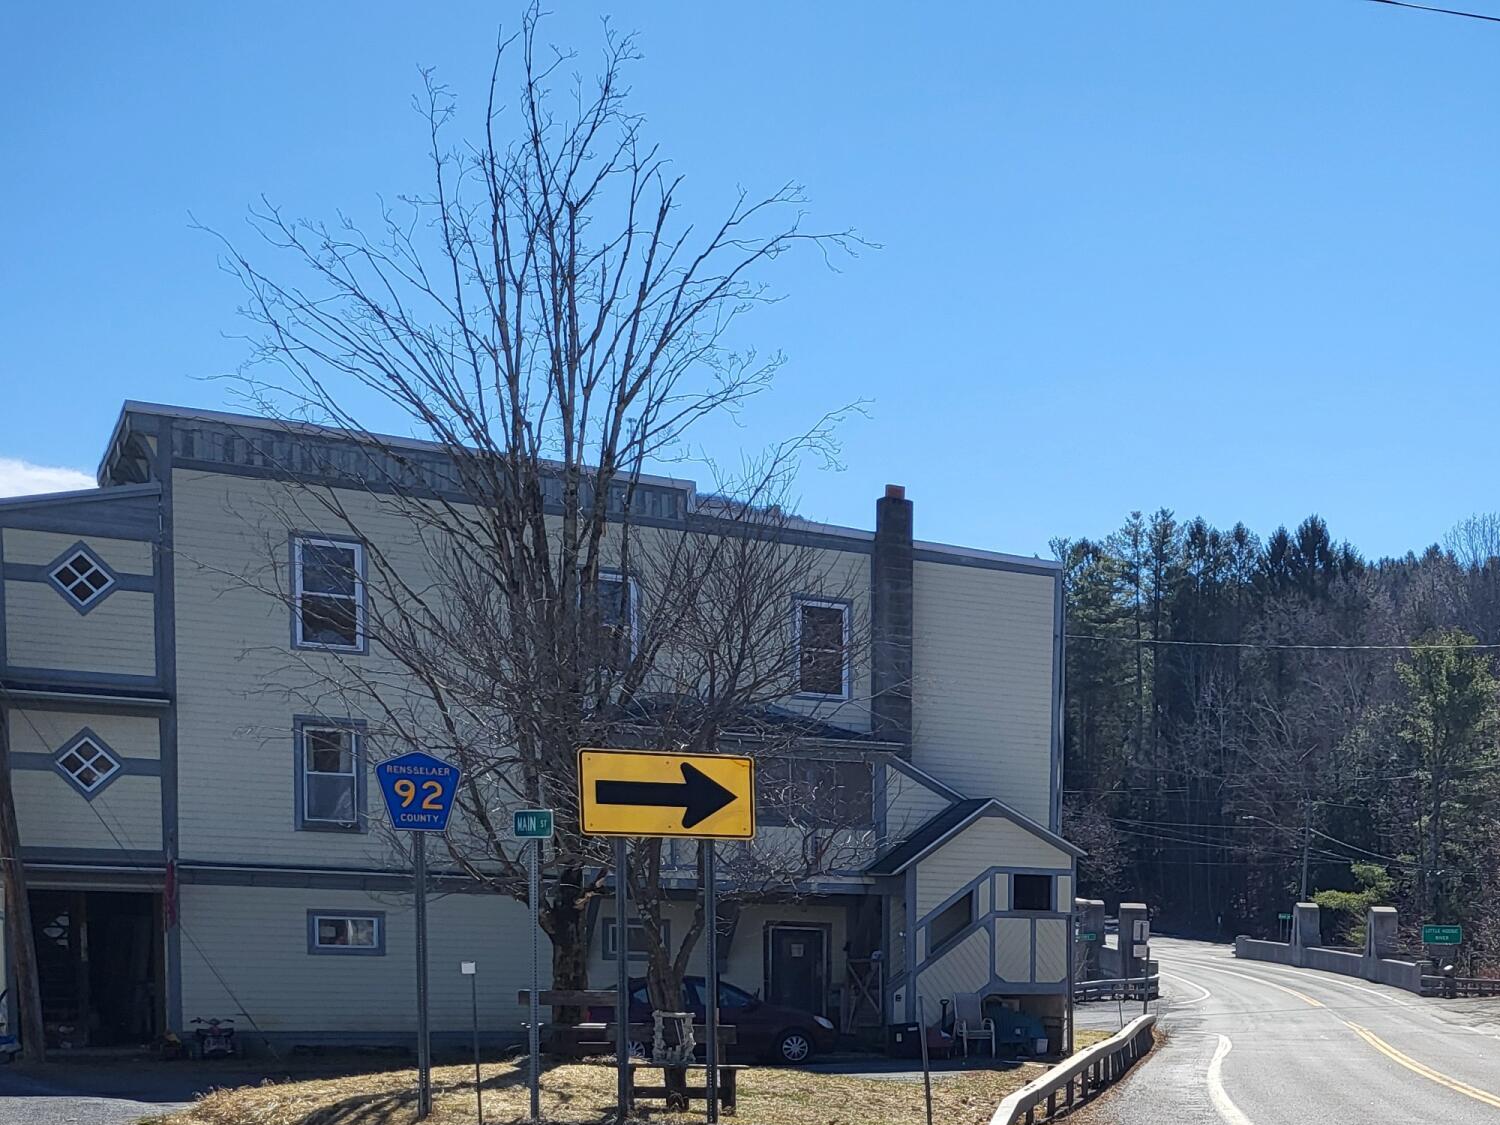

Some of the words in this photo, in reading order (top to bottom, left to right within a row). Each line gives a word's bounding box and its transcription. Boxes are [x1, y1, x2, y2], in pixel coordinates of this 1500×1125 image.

[386, 765, 451, 776] RENSSELAER
[394, 780, 443, 810] 92
[400, 813, 440, 823] COUNTY
[517, 816, 537, 832] MAIN
[540, 820, 547, 829] ST
